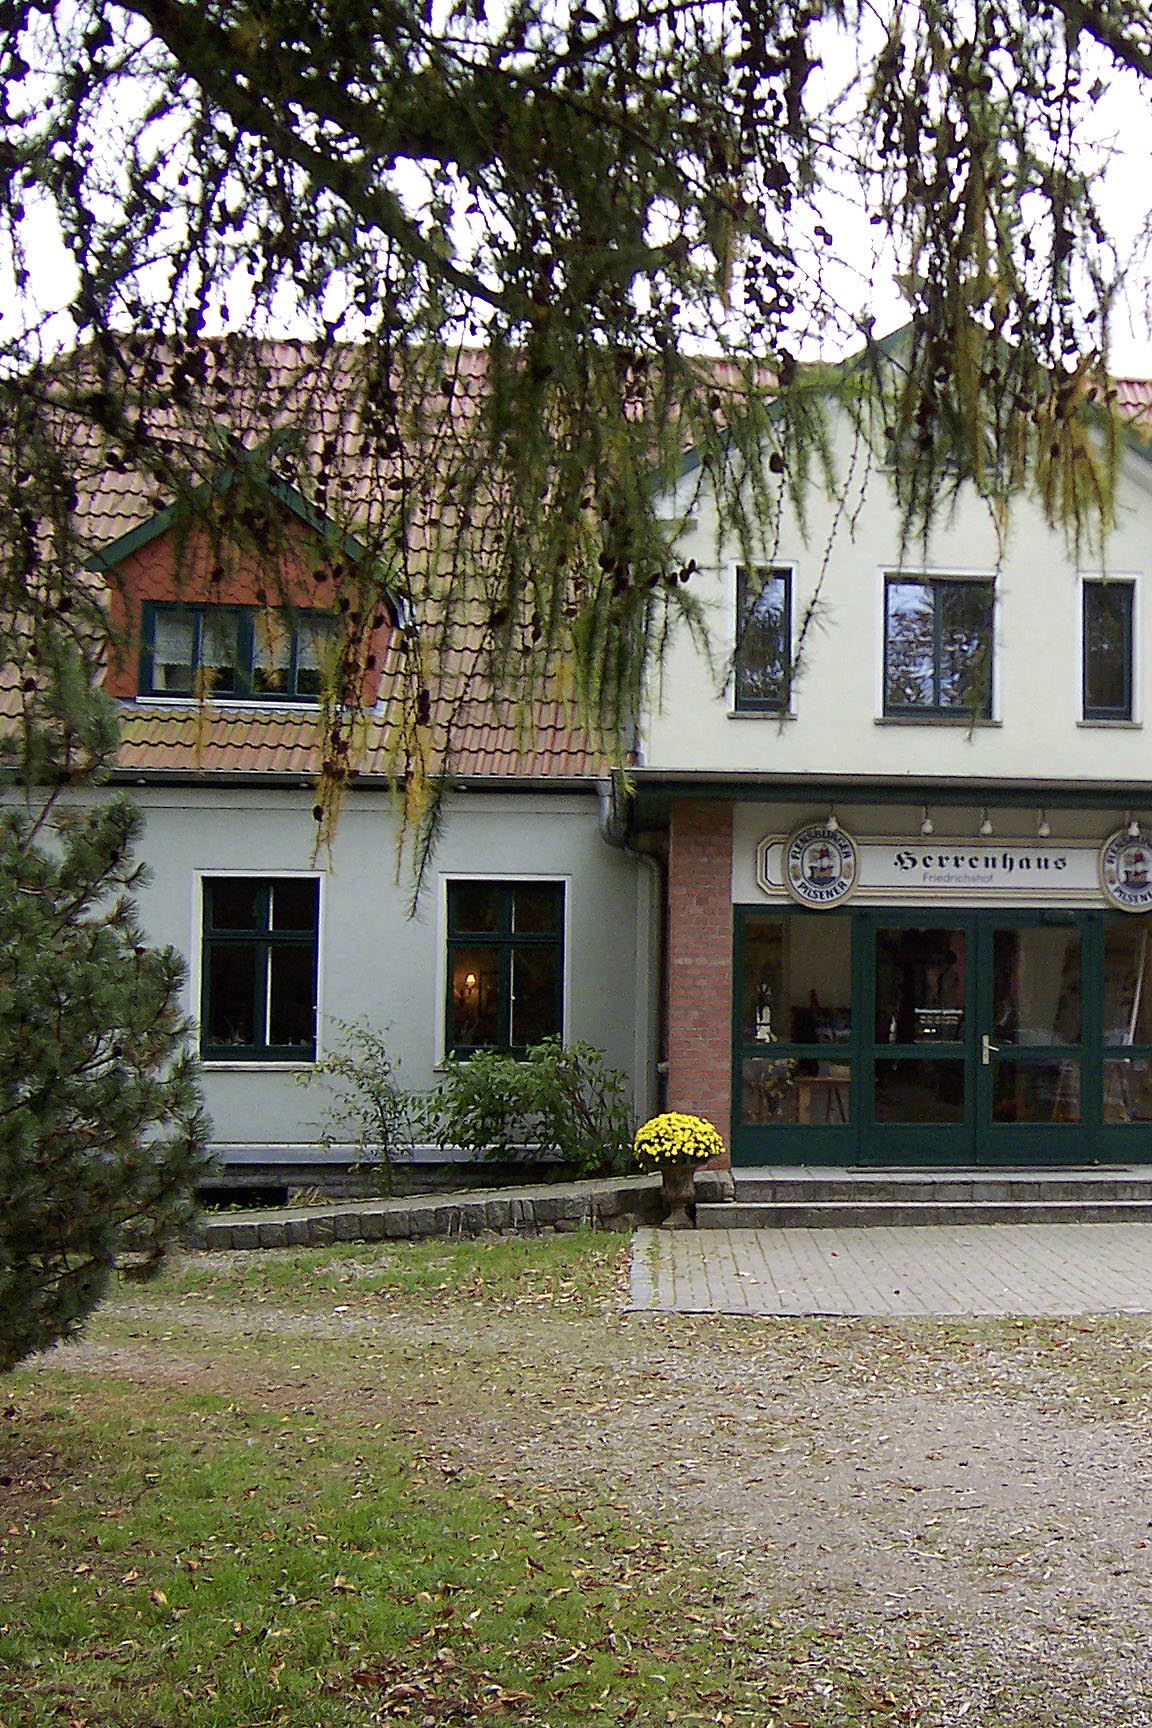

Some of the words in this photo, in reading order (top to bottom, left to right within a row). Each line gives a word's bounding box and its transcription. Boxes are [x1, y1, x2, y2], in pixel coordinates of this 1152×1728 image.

[894, 851, 1067, 872] Herrenhaus
[923, 872, 993, 884] Friedrichshof
[798, 881, 848, 900] PILSENER
